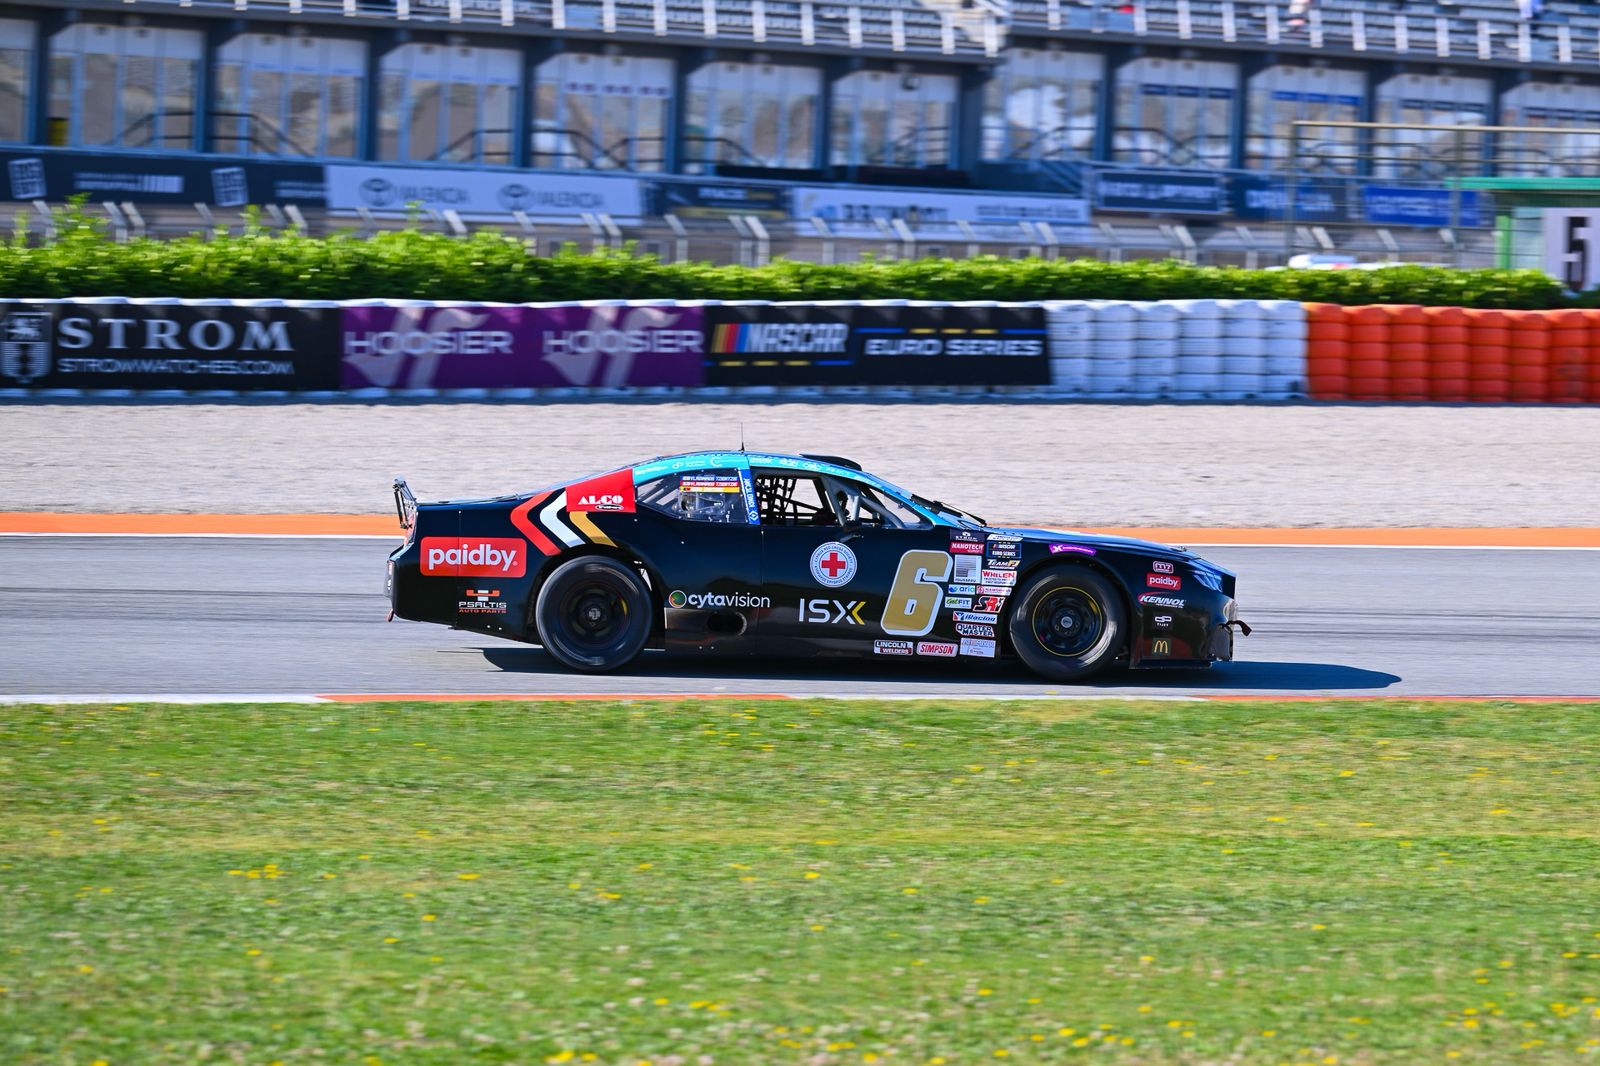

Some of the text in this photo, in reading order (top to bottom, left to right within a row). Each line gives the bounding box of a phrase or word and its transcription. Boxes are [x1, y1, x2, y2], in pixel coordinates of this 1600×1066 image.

[57, 317, 295, 352] STROM
[344, 329, 514, 356] HOOSIER
[542, 328, 704, 354] HOOSIER
[747, 323, 849, 353] NASCAR
[864, 339, 1043, 357] EURO SERIES
[57, 357, 296, 376] STROMWATCHES.COM
[577, 495, 623, 505] ALCO
[428, 543, 517, 571] paidby
[982, 570, 1015, 578] WHELEN
[1149, 576, 1178, 588] paidby
[687, 591, 771, 608] cytavision
[880, 549, 954, 637] 6
[1140, 595, 1185, 606] KENNOL
[965, 614, 996, 622] iRacing
[957, 623, 992, 631] QUARTER
[876, 641, 907, 649] LINCOLN
[920, 644, 955, 654] SIMPSON
